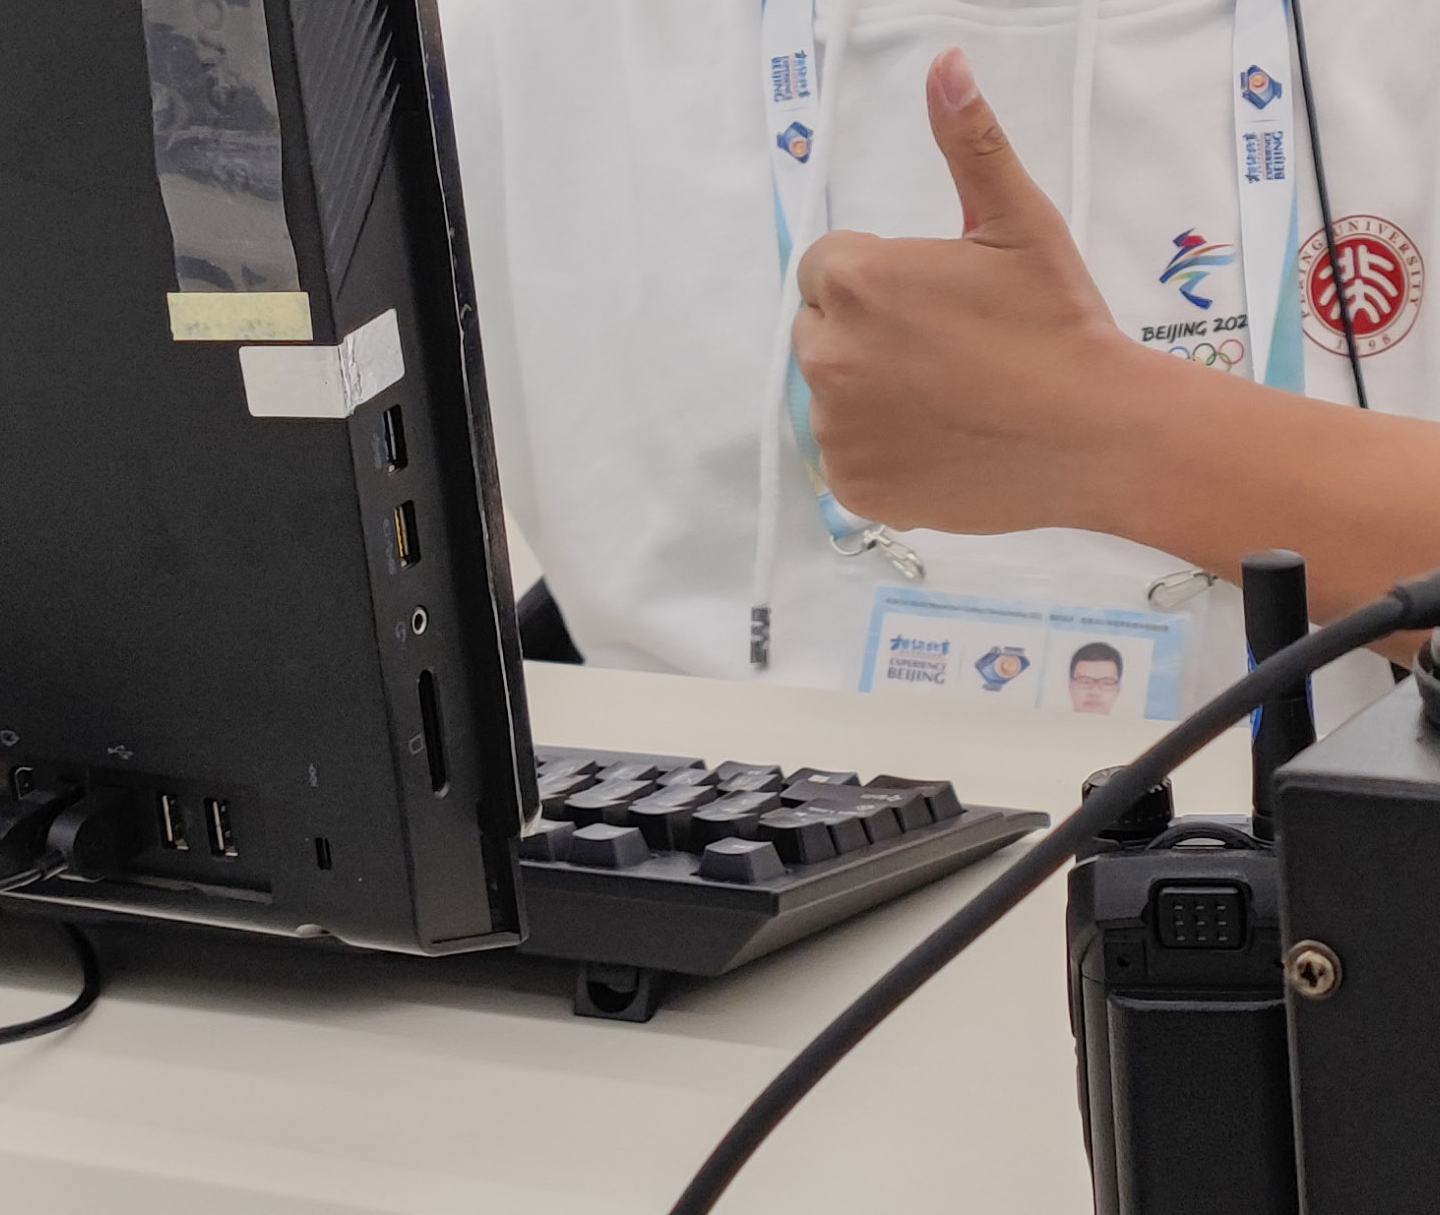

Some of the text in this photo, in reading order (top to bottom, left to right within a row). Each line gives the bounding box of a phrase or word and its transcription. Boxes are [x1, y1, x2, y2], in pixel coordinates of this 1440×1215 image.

[1333, 220, 1421, 307] UNIVERSITY
[1141, 314, 1249, 343] BEIJING 202
[1336, 333, 1391, 350] 198
[887, 667, 946, 685] BEIJING
